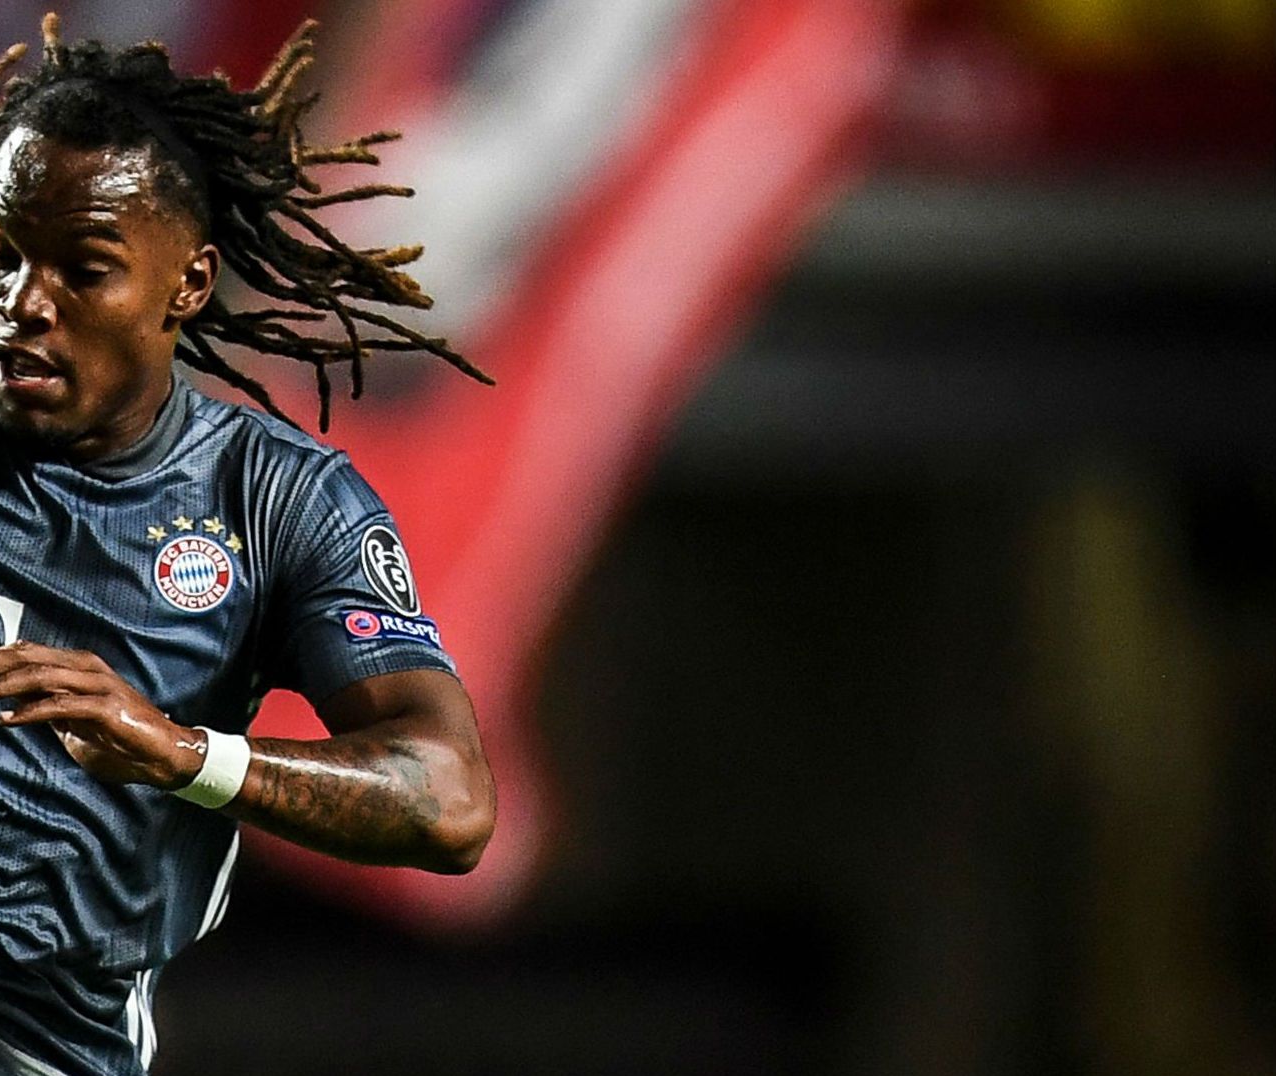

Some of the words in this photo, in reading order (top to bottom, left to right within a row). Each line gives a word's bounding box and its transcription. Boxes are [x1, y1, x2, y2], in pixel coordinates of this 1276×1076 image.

[161, 545, 180, 566] FC
[178, 540, 228, 573] BAYERN
[390, 567, 408, 592] 5
